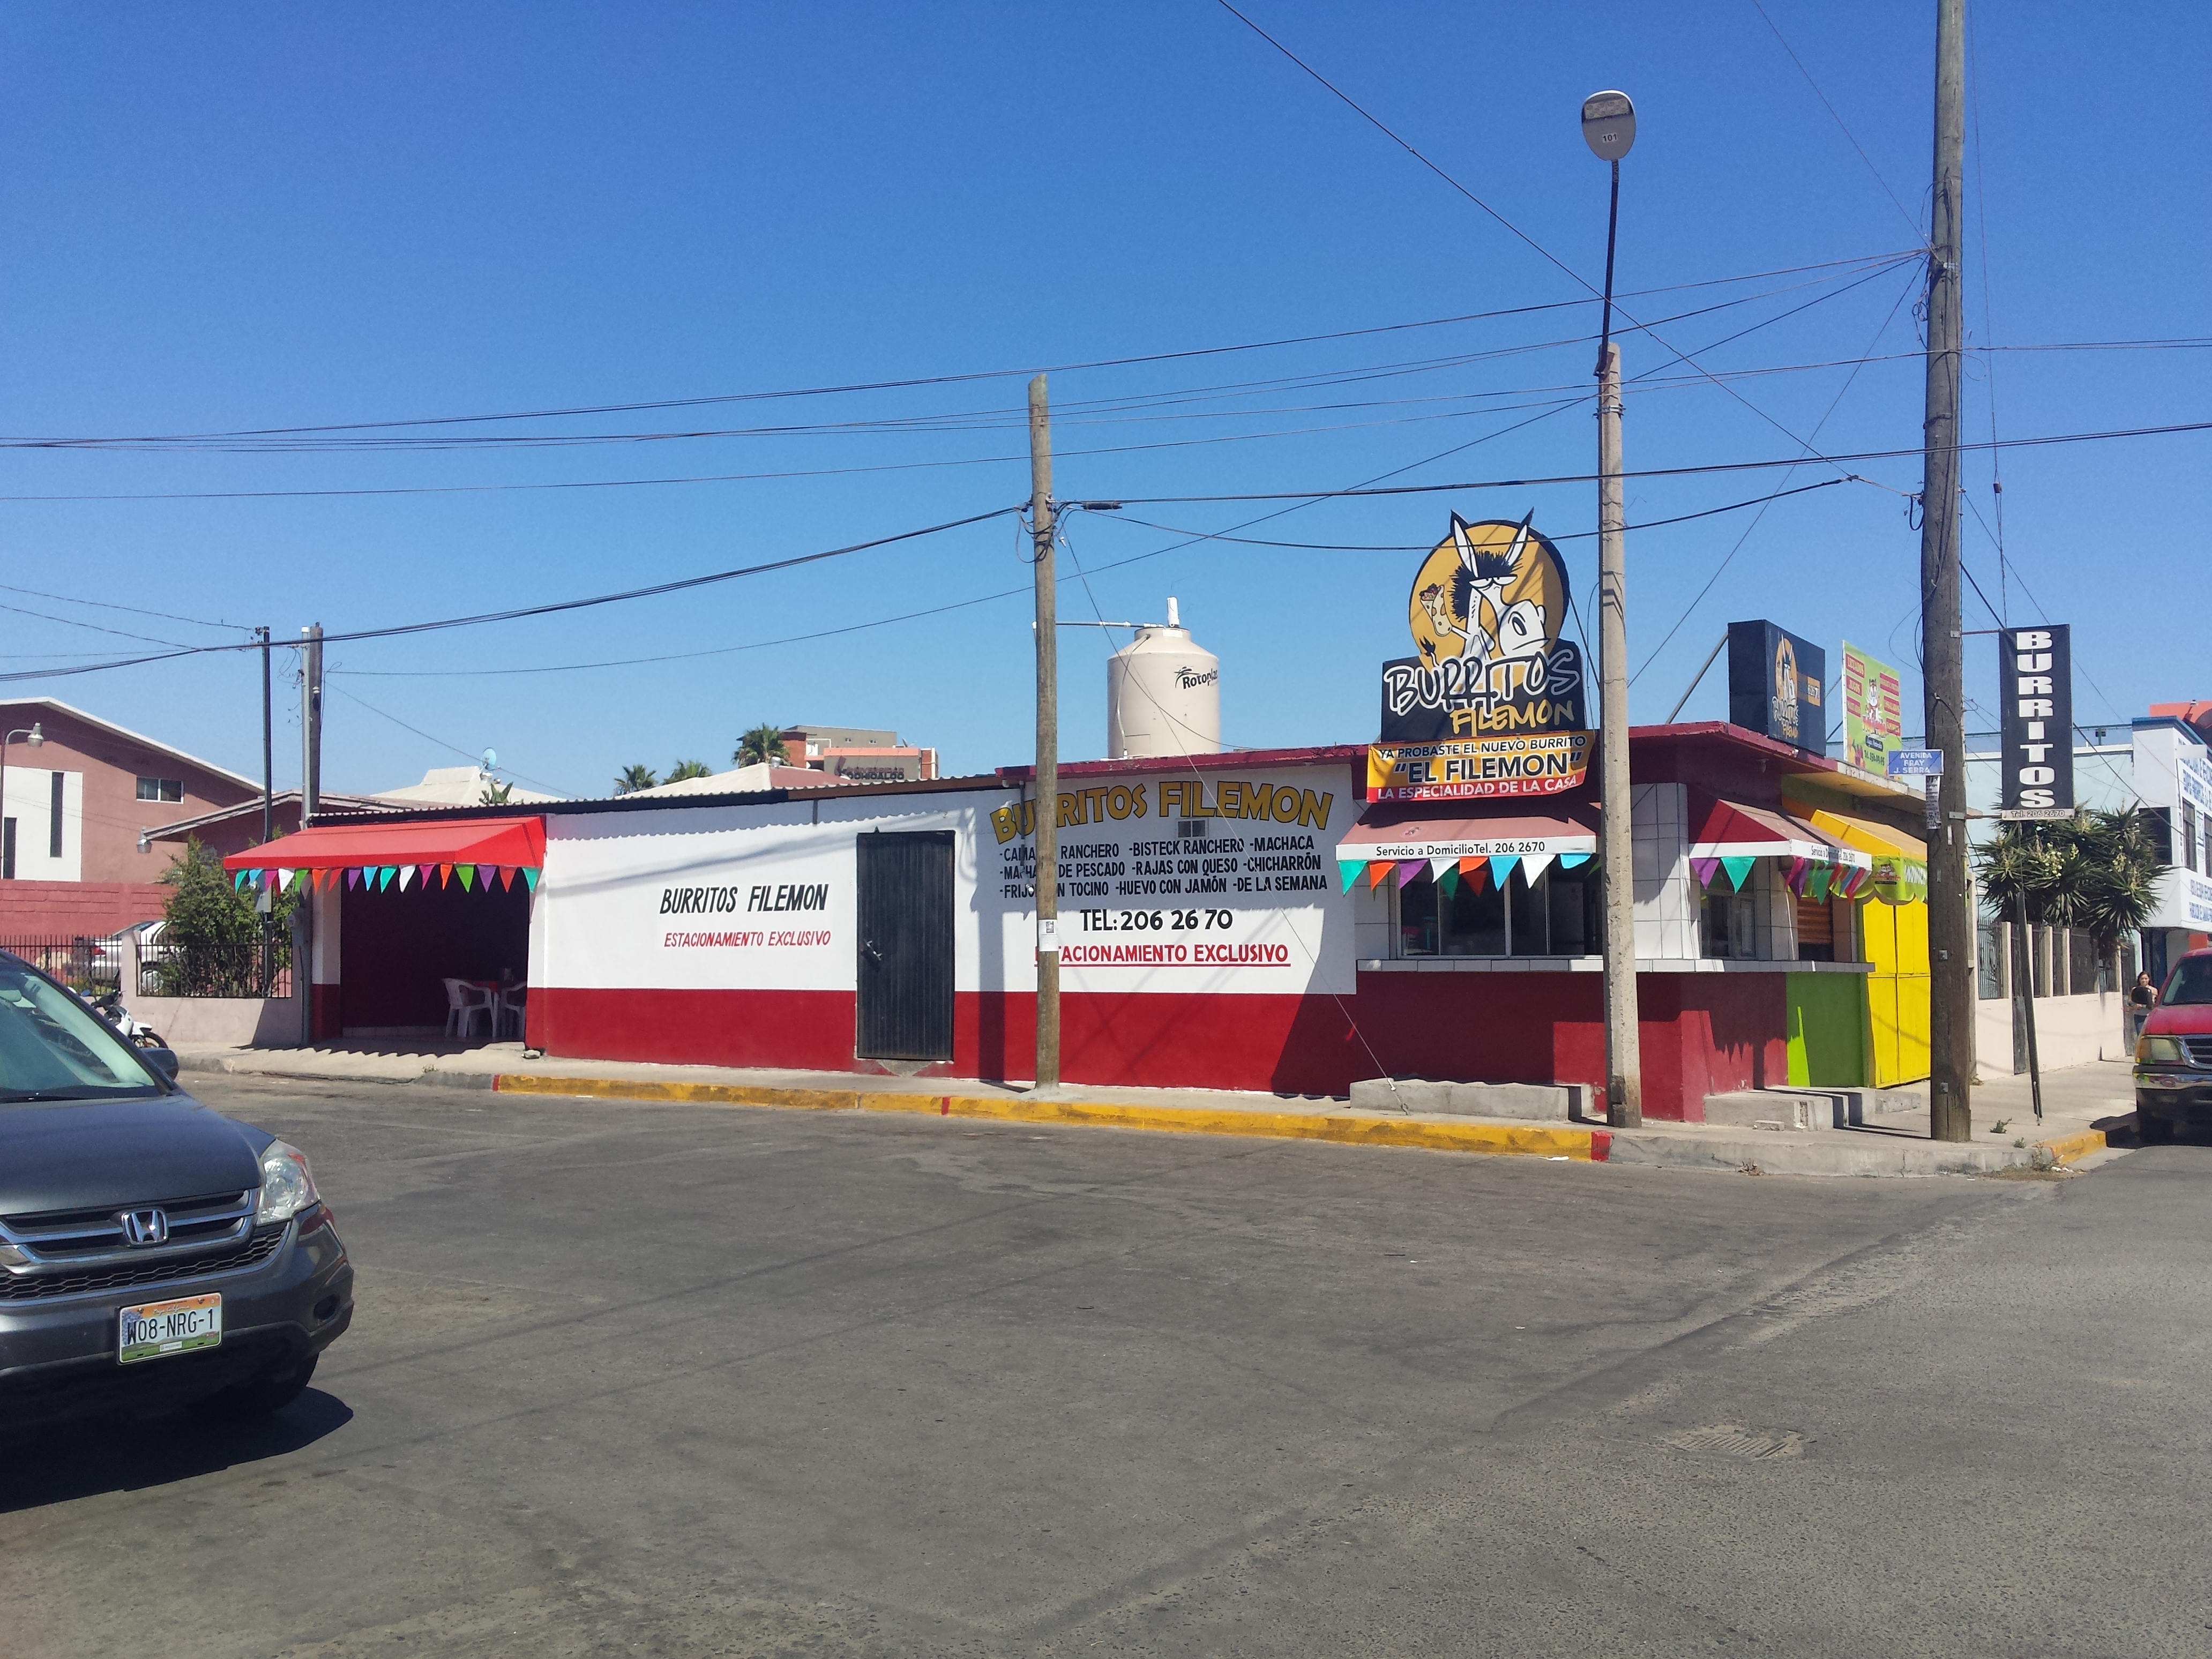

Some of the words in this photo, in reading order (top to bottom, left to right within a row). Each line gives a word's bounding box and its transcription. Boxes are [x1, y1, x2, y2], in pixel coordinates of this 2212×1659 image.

[1603, 133, 1617, 142] 101
[1384, 648, 1580, 718] BURRITOS
[1450, 699, 1574, 736] FILEMON
[2016, 631, 2056, 808] BURRITOS
[1379, 748, 1394, 759] YA
[1398, 744, 1459, 758] PROBASTE
[1463, 743, 1477, 753] EL
[1481, 740, 1526, 753] NUEVO
[1530, 736, 1587, 749] BURRITO
[1378, 788, 1394, 799] LA
[1398, 782, 1495, 798] ESPECIALIDAD
[1499, 781, 1518, 793] DE
[1523, 780, 1541, 792] LA
[1544, 775, 1577, 791] CASA
[990, 783, 1147, 845] BURITOS
[1159, 781, 1334, 830] FILEMON
[1060, 843, 1119, 860] RANCHERO
[1183, 839, 1244, 855] RANCHERO
[1376, 846, 1415, 856] Servicio
[1495, 842, 1515, 853] 206
[1518, 841, 1545, 852] 2670
[1058, 864, 1072, 878] DE
[1076, 862, 1125, 878] PESCADO
[1177, 859, 1198, 875] CON
[1202, 857, 1238, 876] QUESO
[1069, 881, 1109, 896] TOCINO
[1160, 879, 1181, 894] CON
[1185, 876, 1227, 893] JAMÓN
[1256, 876, 1272, 892] LA
[1275, 875, 1328, 891] SEMANA
[659, 886, 738, 914] BURRITOS
[747, 884, 829, 912] FILEMON
[1171, 910, 1199, 930] 26
[1205, 909, 1233, 930] 70
[664, 931, 764, 947] ESTACIONAMIENTO
[768, 930, 831, 946] EXCLUSIVO
[1194, 944, 1287, 962] EXCLUSIVO
